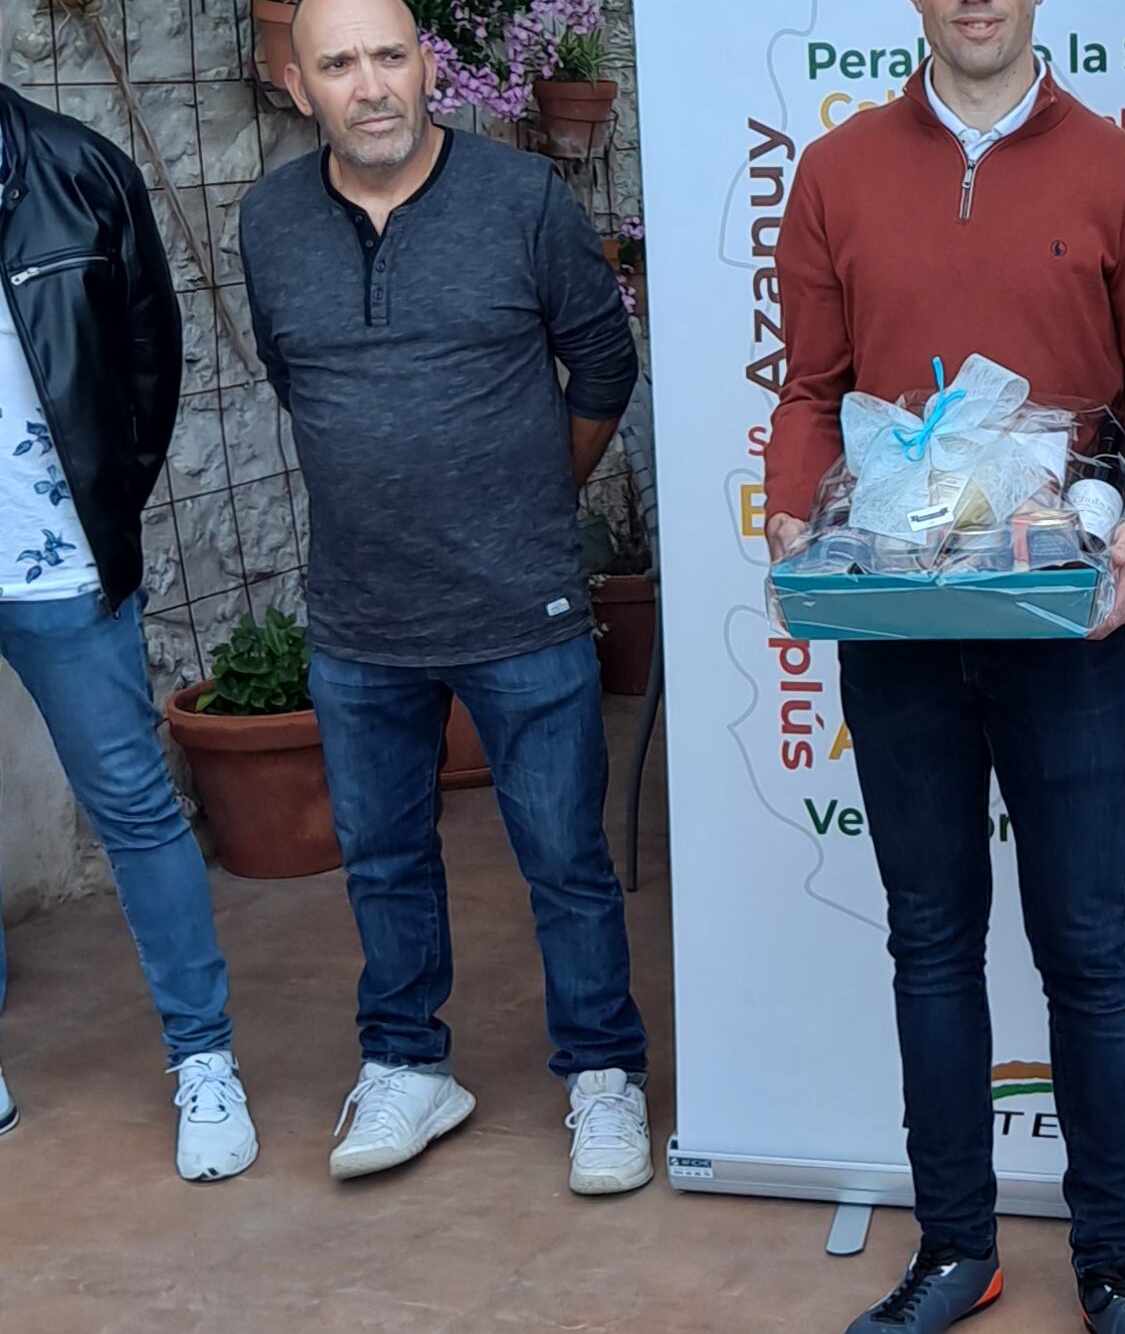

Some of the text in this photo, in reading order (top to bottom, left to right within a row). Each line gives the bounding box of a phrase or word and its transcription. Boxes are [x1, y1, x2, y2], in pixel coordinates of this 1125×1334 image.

[807, 37, 926, 79] Peral
[1069, 33, 1107, 74] la
[746, 116, 796, 395] Azanuy
[768, 637, 825, 770] plús
